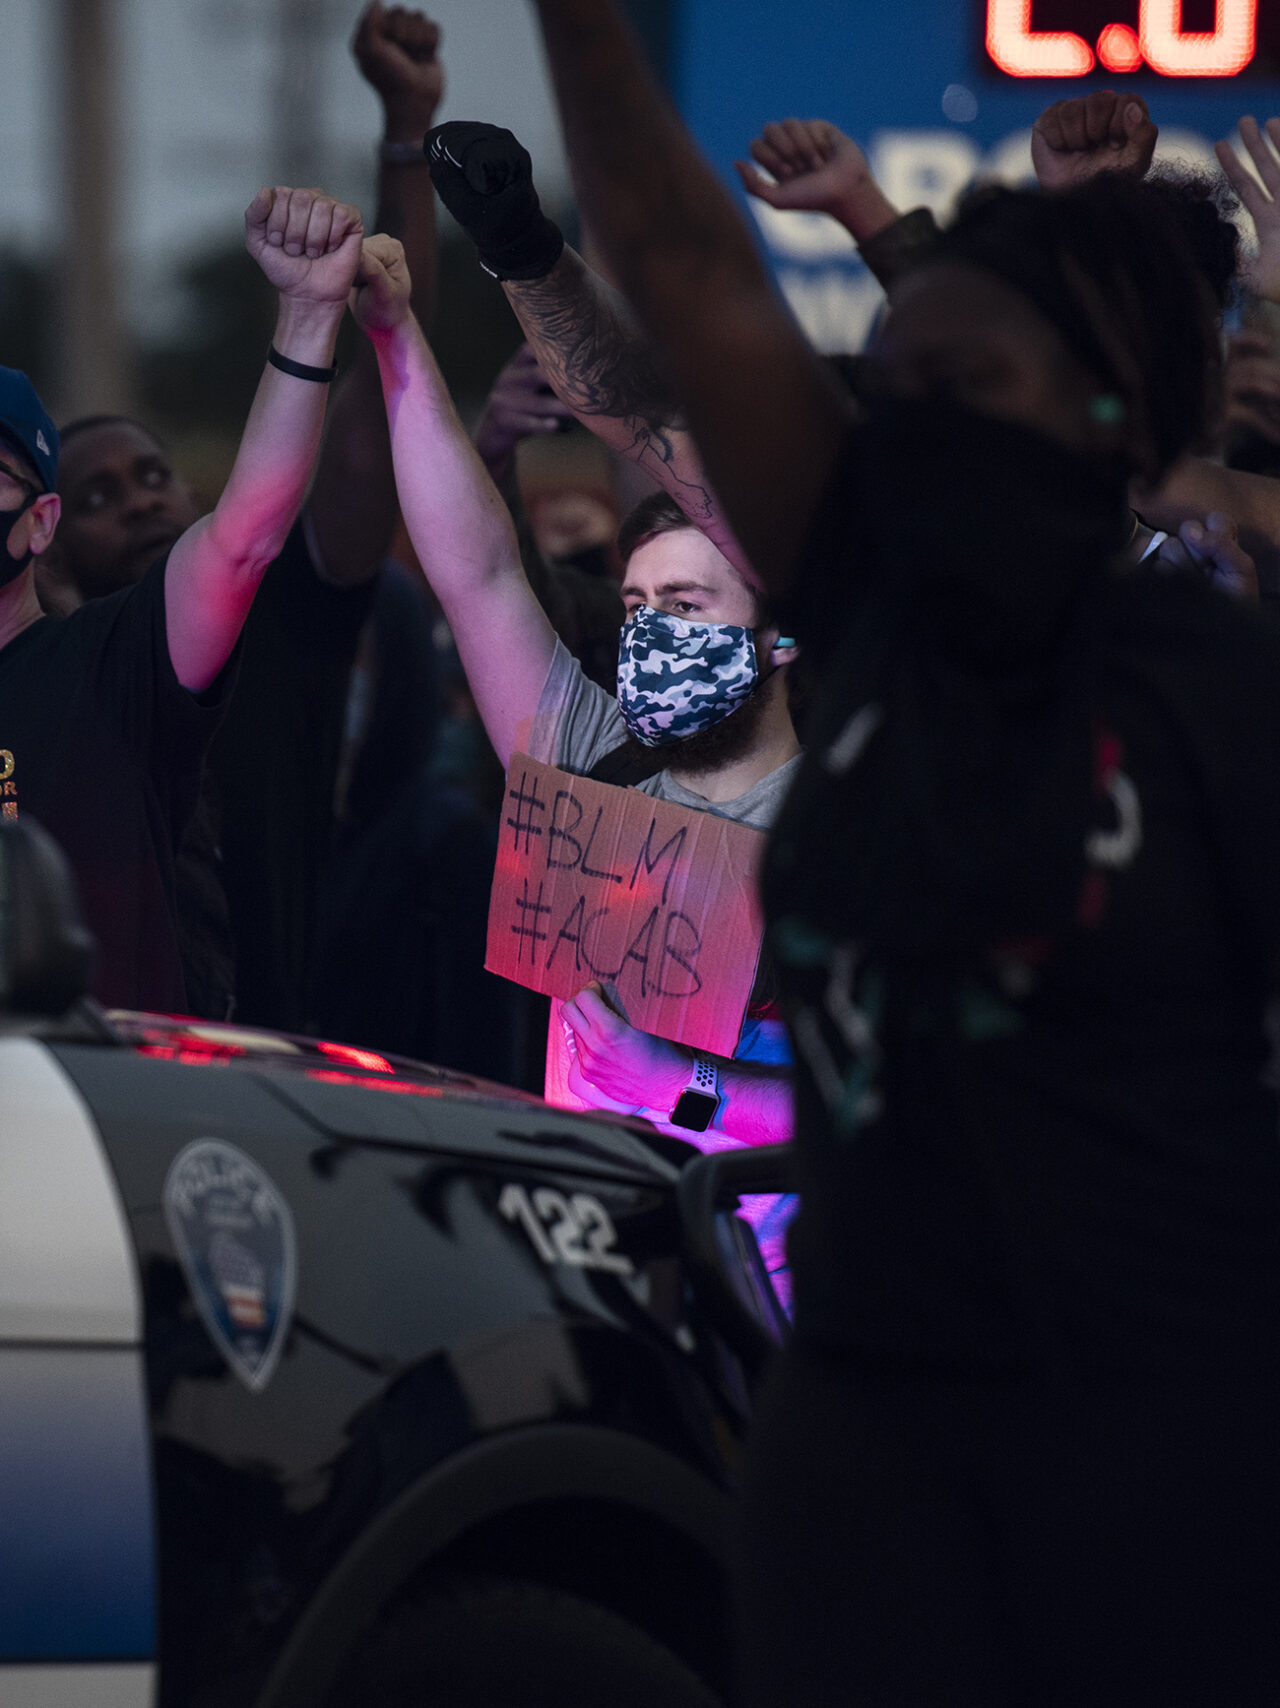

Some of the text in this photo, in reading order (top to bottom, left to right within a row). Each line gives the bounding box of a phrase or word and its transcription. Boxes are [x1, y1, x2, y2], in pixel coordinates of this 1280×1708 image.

[508, 771, 687, 904] #BLM
[510, 878, 702, 998] #ACAB
[498, 1184, 634, 1276] 122
